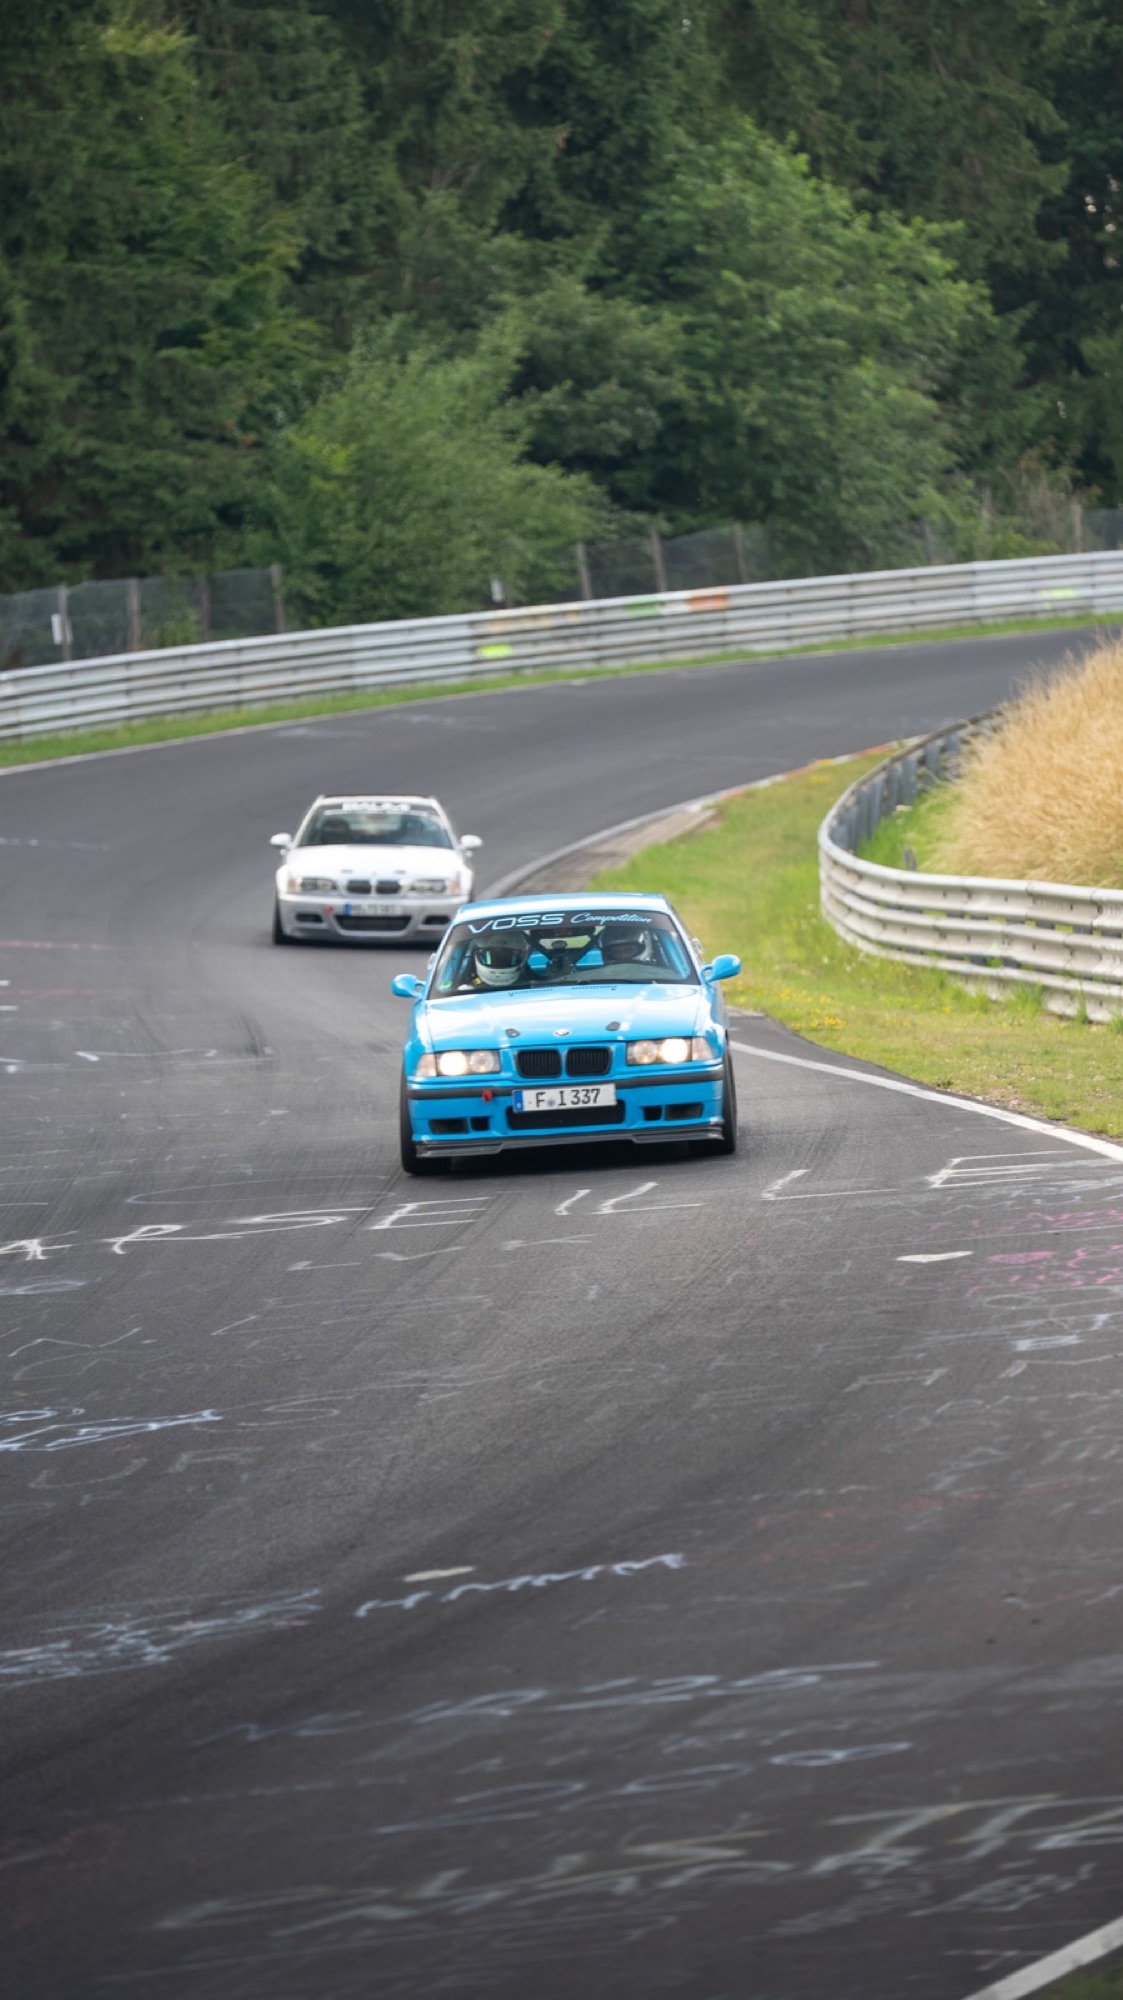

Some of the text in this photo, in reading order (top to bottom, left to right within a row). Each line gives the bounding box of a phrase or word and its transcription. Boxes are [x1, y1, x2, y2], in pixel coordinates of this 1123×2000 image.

[468, 912, 653, 934] VOSS Competition
[535, 1091, 546, 1108] F
